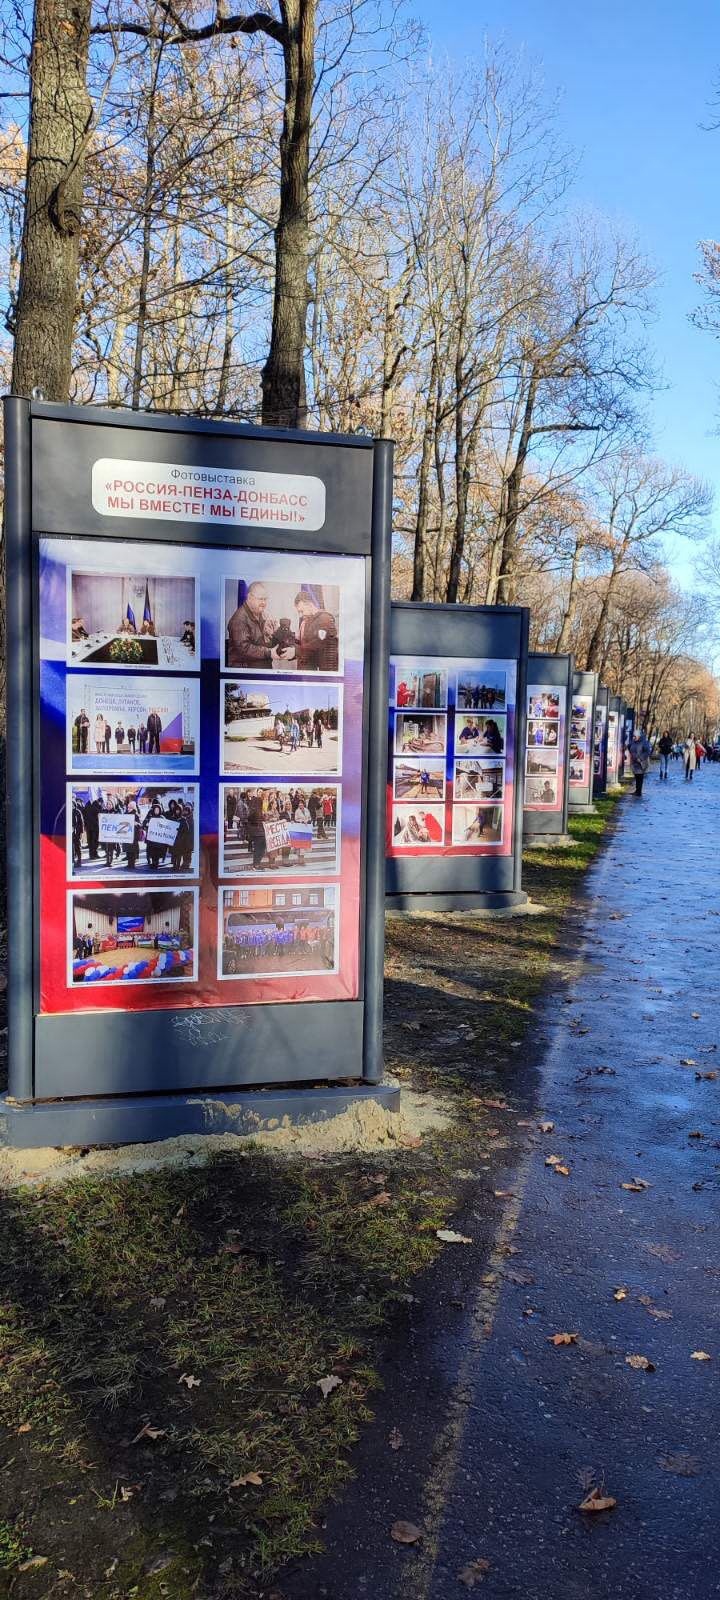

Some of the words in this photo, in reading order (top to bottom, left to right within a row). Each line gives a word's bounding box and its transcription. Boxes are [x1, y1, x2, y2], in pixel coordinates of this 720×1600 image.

[170, 469, 256, 485] Фотовыставка
[105, 479, 308, 507] «РОССИЯ-ПЕНЗА-ДОНБАСС
[107, 496, 134, 510] МЫ
[139, 499, 205, 515] ВМЕСТЕ!
[210, 505, 236, 517] МЫ
[240, 506, 306, 523] ЕДИНЫ!»
